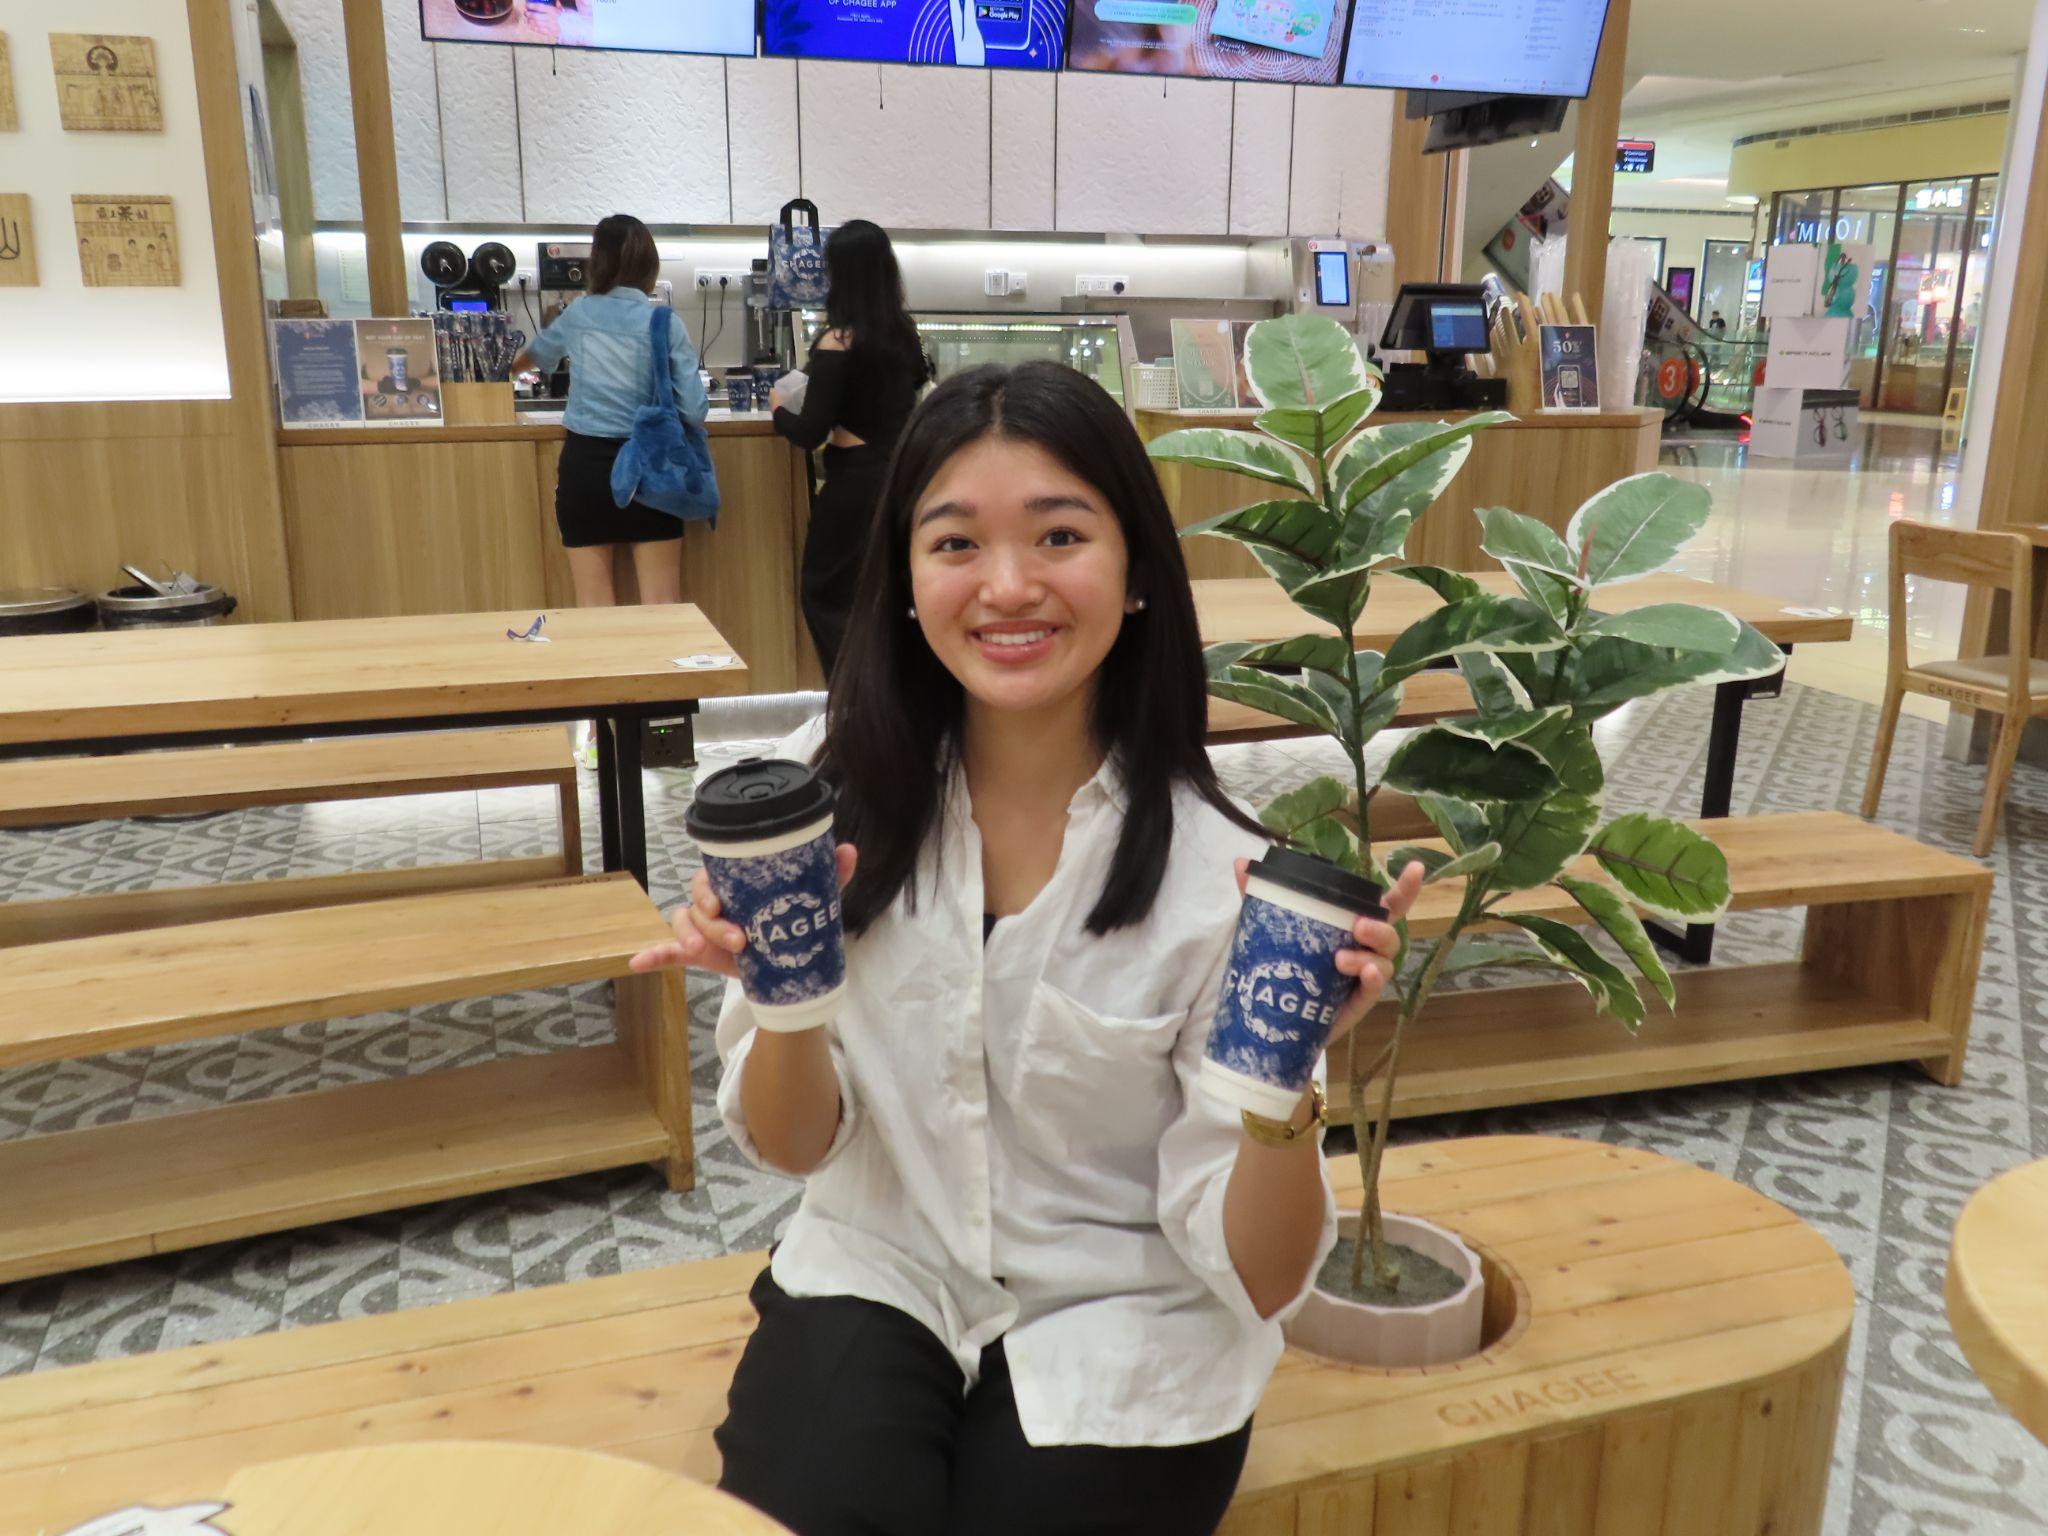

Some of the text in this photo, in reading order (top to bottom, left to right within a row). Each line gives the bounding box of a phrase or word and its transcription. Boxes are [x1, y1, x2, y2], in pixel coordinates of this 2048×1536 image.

[880, 1, 897, 9] APP
[989, 11, 1020, 20] Google Play
[1664, 365, 1675, 391] 3
[1928, 682, 1982, 704] CHAGEE
[744, 900, 839, 943] HAGEE
[1223, 969, 1334, 1025] CHAGEE
[1437, 1367, 1648, 1427] CHAGEE
